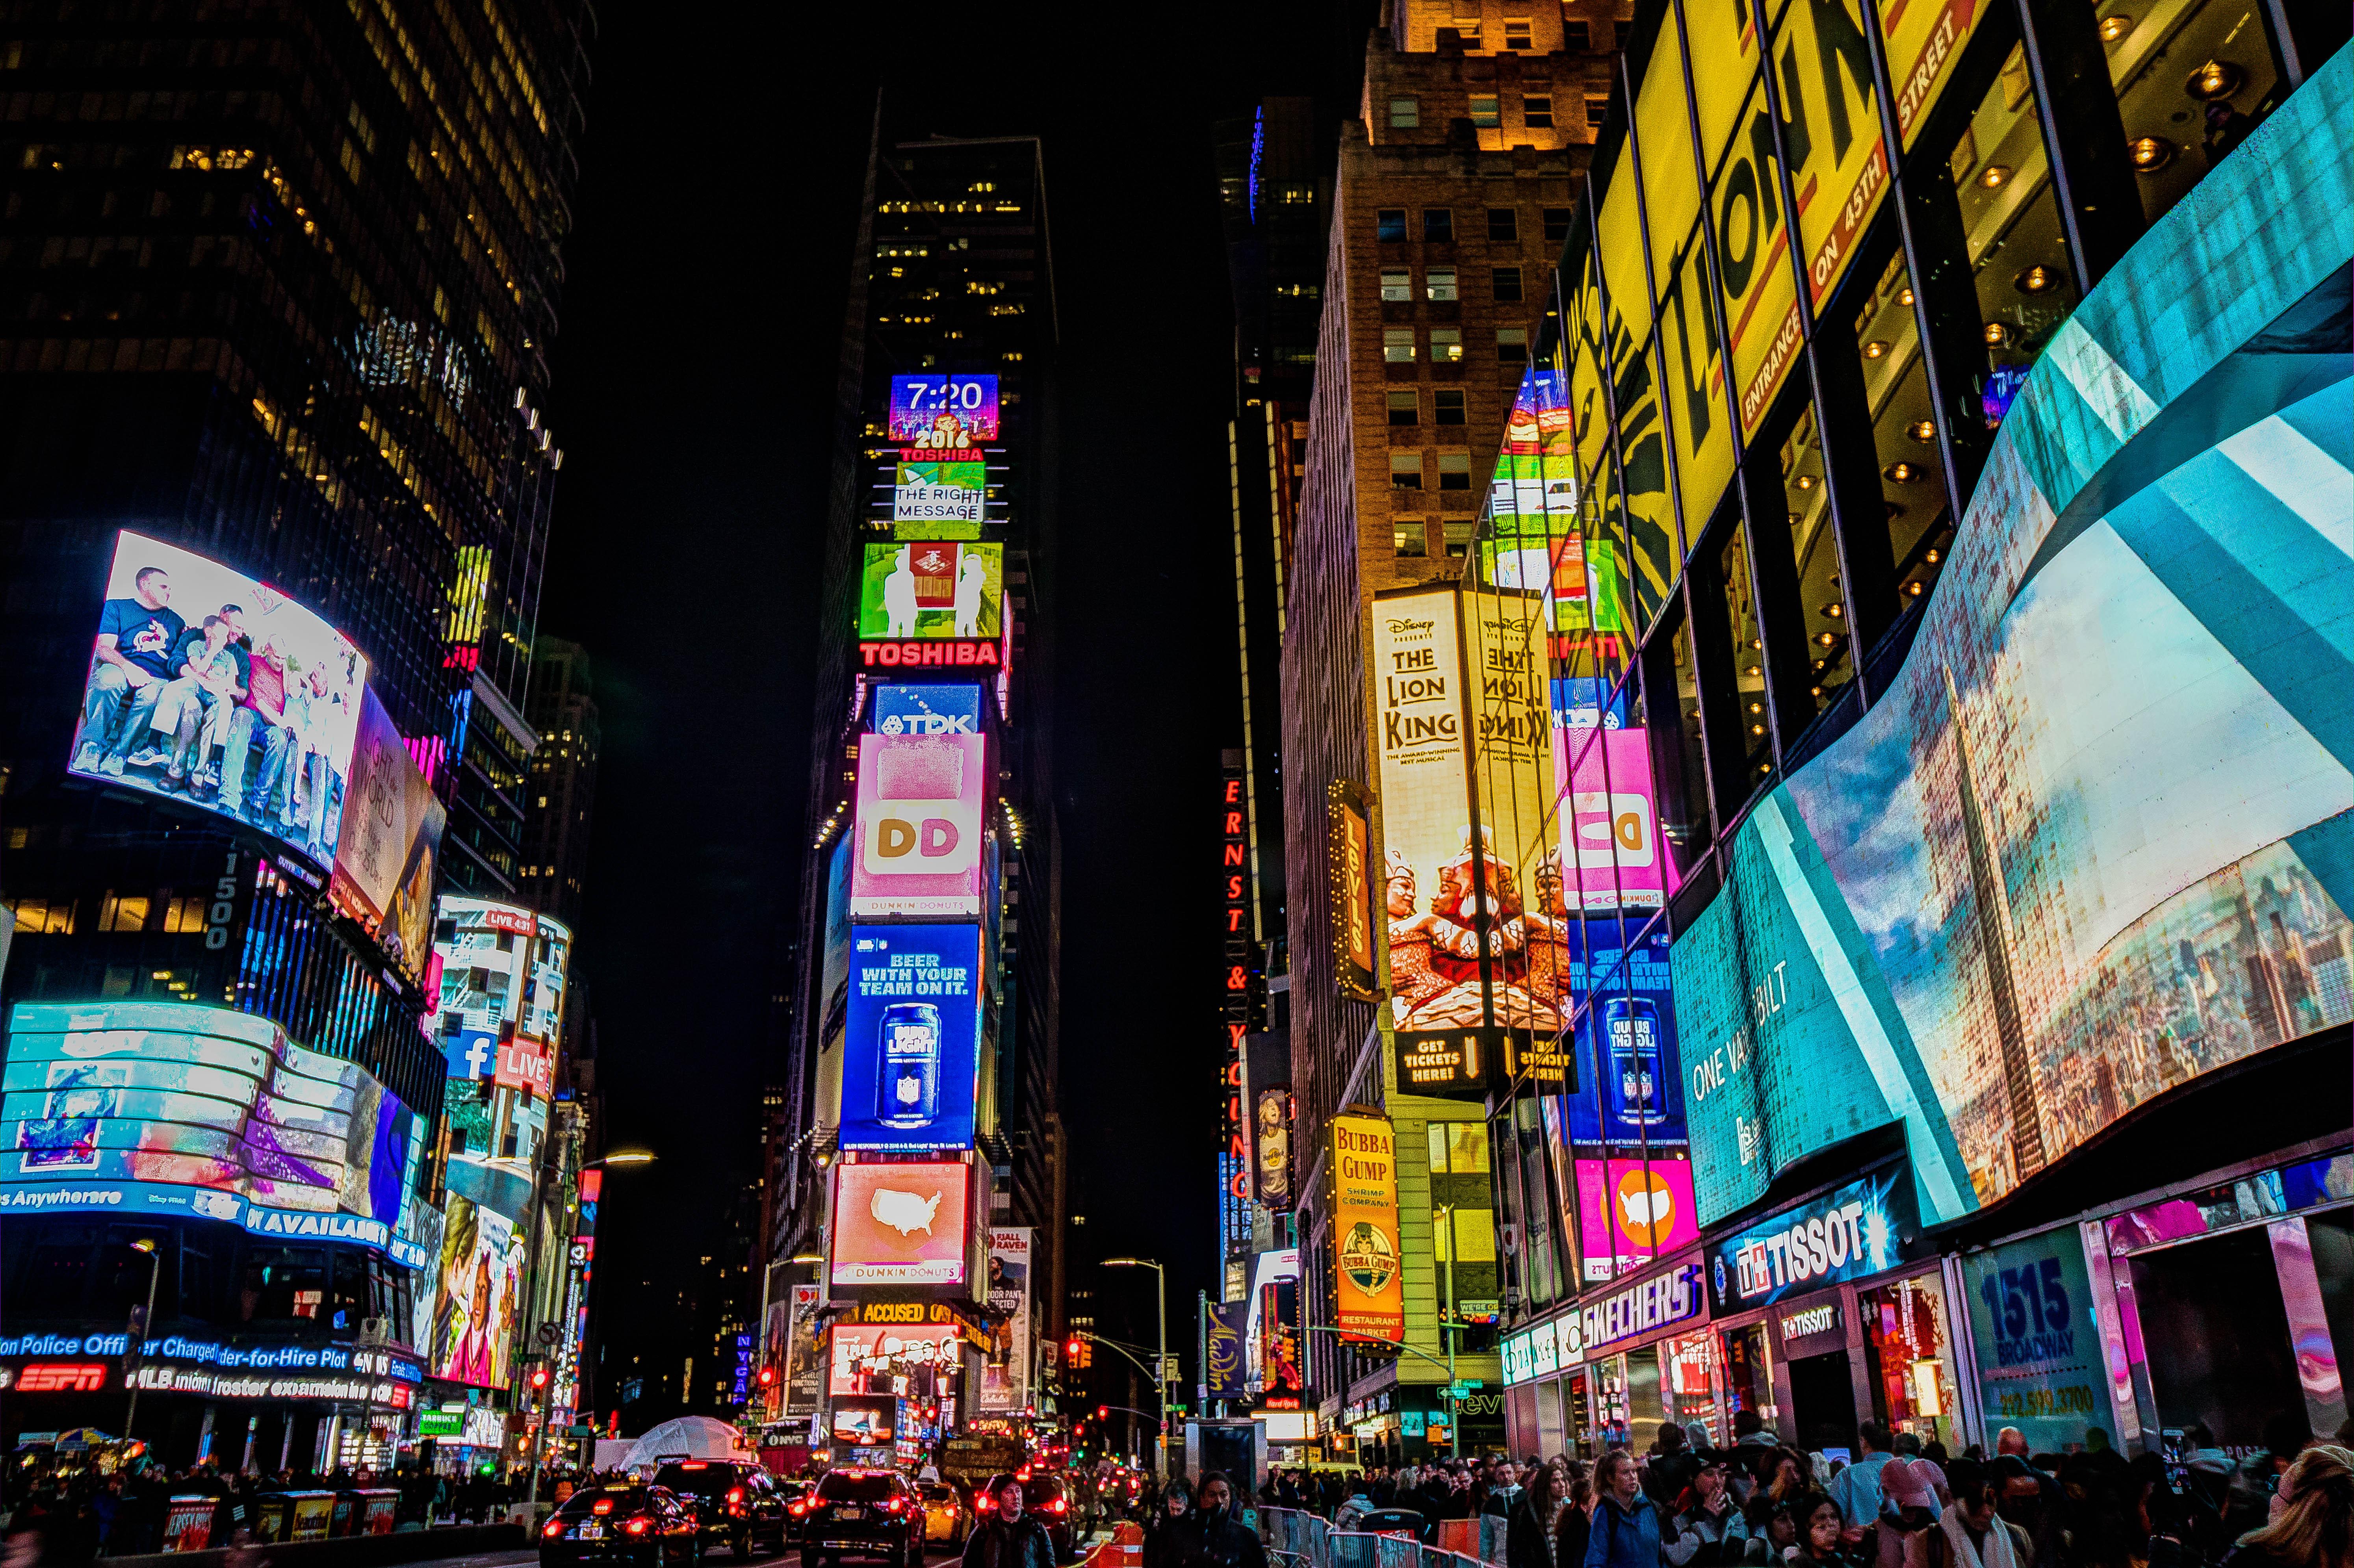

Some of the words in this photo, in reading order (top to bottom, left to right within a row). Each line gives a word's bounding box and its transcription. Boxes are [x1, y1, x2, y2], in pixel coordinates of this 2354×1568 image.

[1745, 307, 1800, 421] ENTRANCE
[1816, 239, 1838, 286] ON
[1844, 152, 1880, 231] 45TH
[1899, 10, 1955, 129] STREET
[907, 383, 982, 409] 7:20
[915, 431, 970, 448] 2016
[900, 448, 984, 461] TOSHIBA
[896, 489, 927, 500] THE
[933, 489, 982, 503] RIGHT
[899, 505, 978, 520] MESSAGE
[1394, 634, 1433, 643] PRESENTS
[860, 642, 997, 665] TOSHIBA
[1392, 649, 1434, 669] THE
[1386, 676, 1445, 707] LION
[902, 714, 972, 734] TDK
[1385, 711, 1457, 750] KING
[1401, 748, 1460, 758] AWARD-WINNING
[1416, 755, 1445, 764] MUSICAL
[878, 818, 958, 857] DD
[1225, 781, 1243, 932] ERNST
[206, 853, 237, 950] 1500
[920, 902, 964, 910] DONUTS
[491, 914, 512, 928] LIVE
[891, 954, 939, 967] BEER
[862, 969, 912, 982] WITH
[916, 969, 967, 981] YOUR
[1228, 966, 1247, 989] &
[860, 982, 912, 995] TEAM
[916, 983, 941, 995] ON
[945, 982, 968, 995] IT.
[889, 1039, 935, 1053] LIGHT
[1418, 1041, 1445, 1052] GET
[507, 1050, 546, 1081] LIVE
[1405, 1053, 1460, 1067] TICKETS
[1413, 1067, 1454, 1082] HERE!
[1694, 1047, 1725, 1100] ONE
[1337, 1126, 1390, 1154] BUBBA
[1342, 1156, 1387, 1181] GUMP
[1347, 1187, 1384, 1197] SHRIMP
[1342, 1197, 1389, 1209] COMPANY
[1767, 1201, 1862, 1287] TISSOT
[1342, 1256, 1370, 1268] BUBBA
[1371, 1255, 1395, 1271] GUMP
[911, 1267, 954, 1277] DONUTS
[1583, 1264, 1689, 1349] SKECHERS
[1981, 1257, 2069, 1340] 1515
[864, 1304, 923, 1322] ACCUSED
[1341, 1316, 1400, 1326] RESTAURANT
[1795, 1306, 1832, 1336] TISSOT
[1352, 1328, 1391, 1338] MARKET
[20, 1335, 78, 1355] Police
[163, 1339, 215, 1362] Charged
[320, 1350, 345, 1368] Plot
[1998, 1331, 2074, 1366] BROADWAY
[18, 1367, 103, 1390] ESPN
[1267, 1399, 1283, 1408] Hard
[1283, 1399, 1299, 1408] Rock
